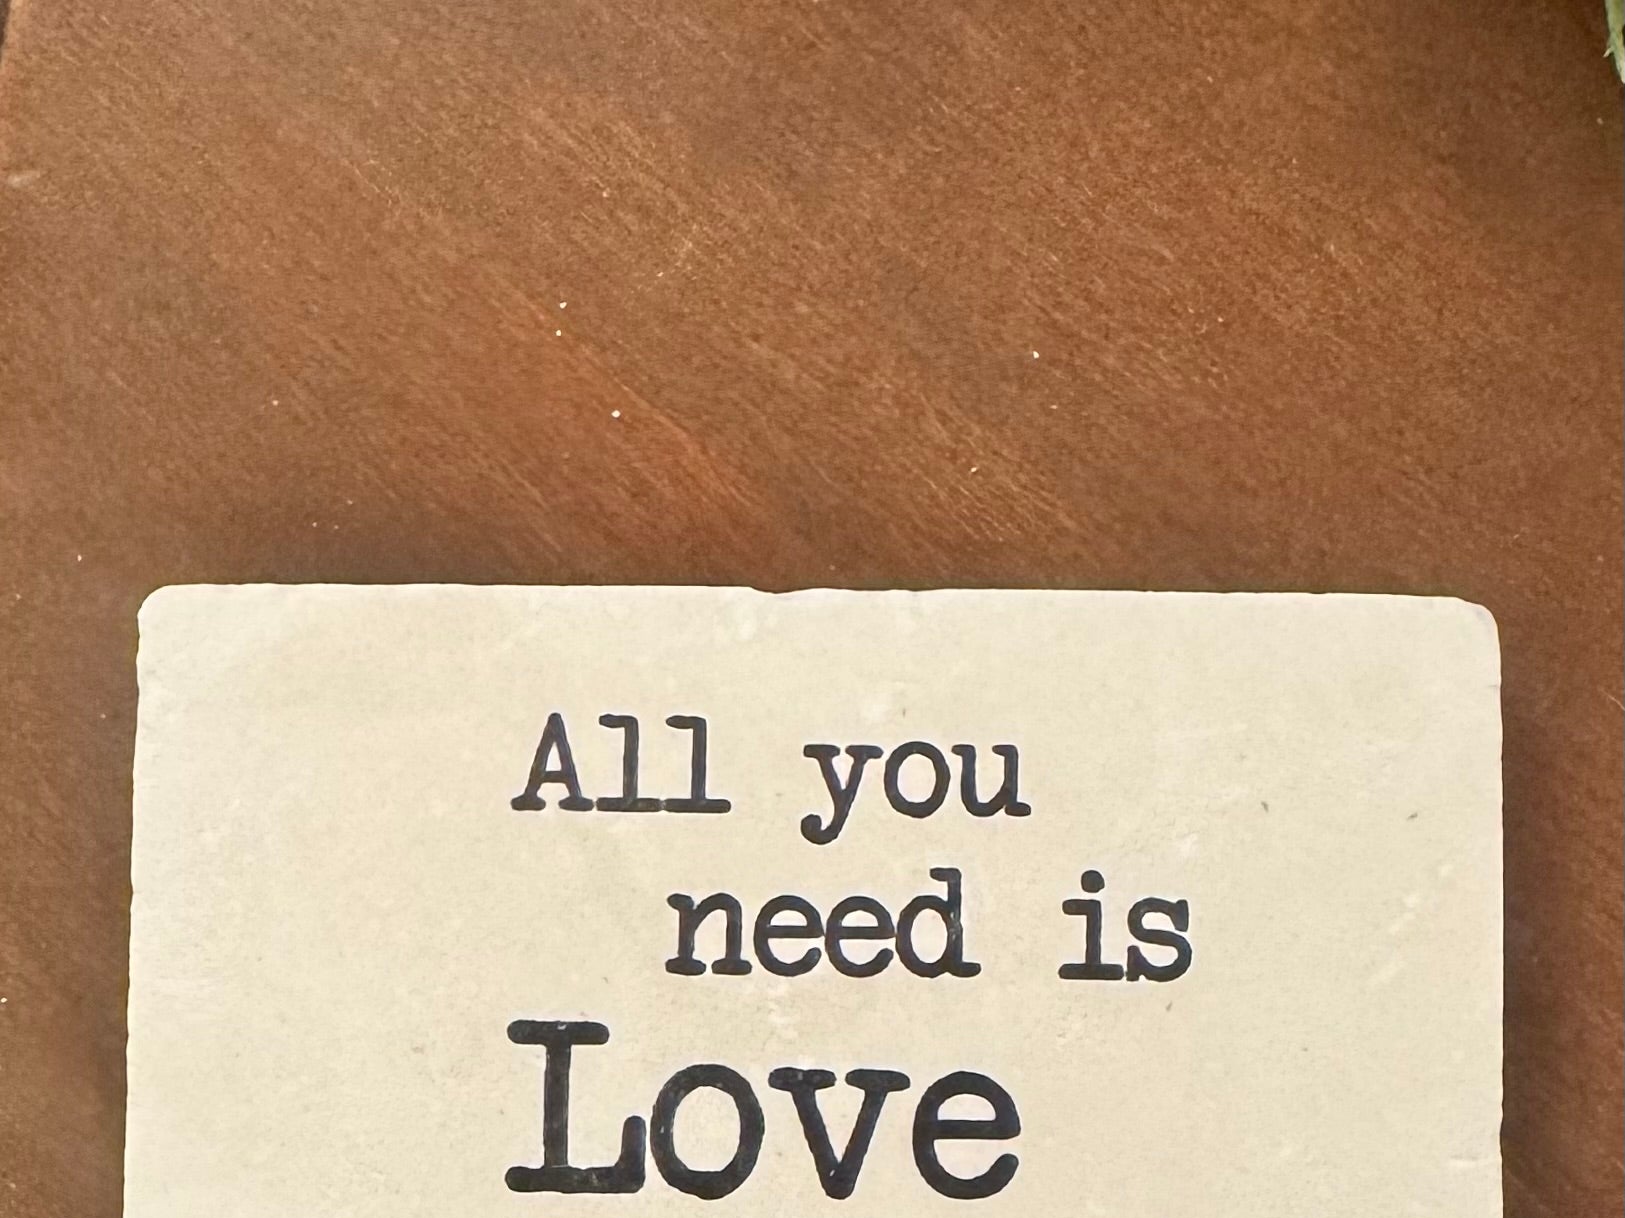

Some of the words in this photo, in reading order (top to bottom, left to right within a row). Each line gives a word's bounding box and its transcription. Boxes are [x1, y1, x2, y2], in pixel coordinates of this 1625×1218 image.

[510, 712, 732, 814] All
[800, 741, 1032, 845] you
[665, 867, 982, 978] need
[1058, 869, 1193, 983] is
[505, 1019, 1022, 1201] Love
